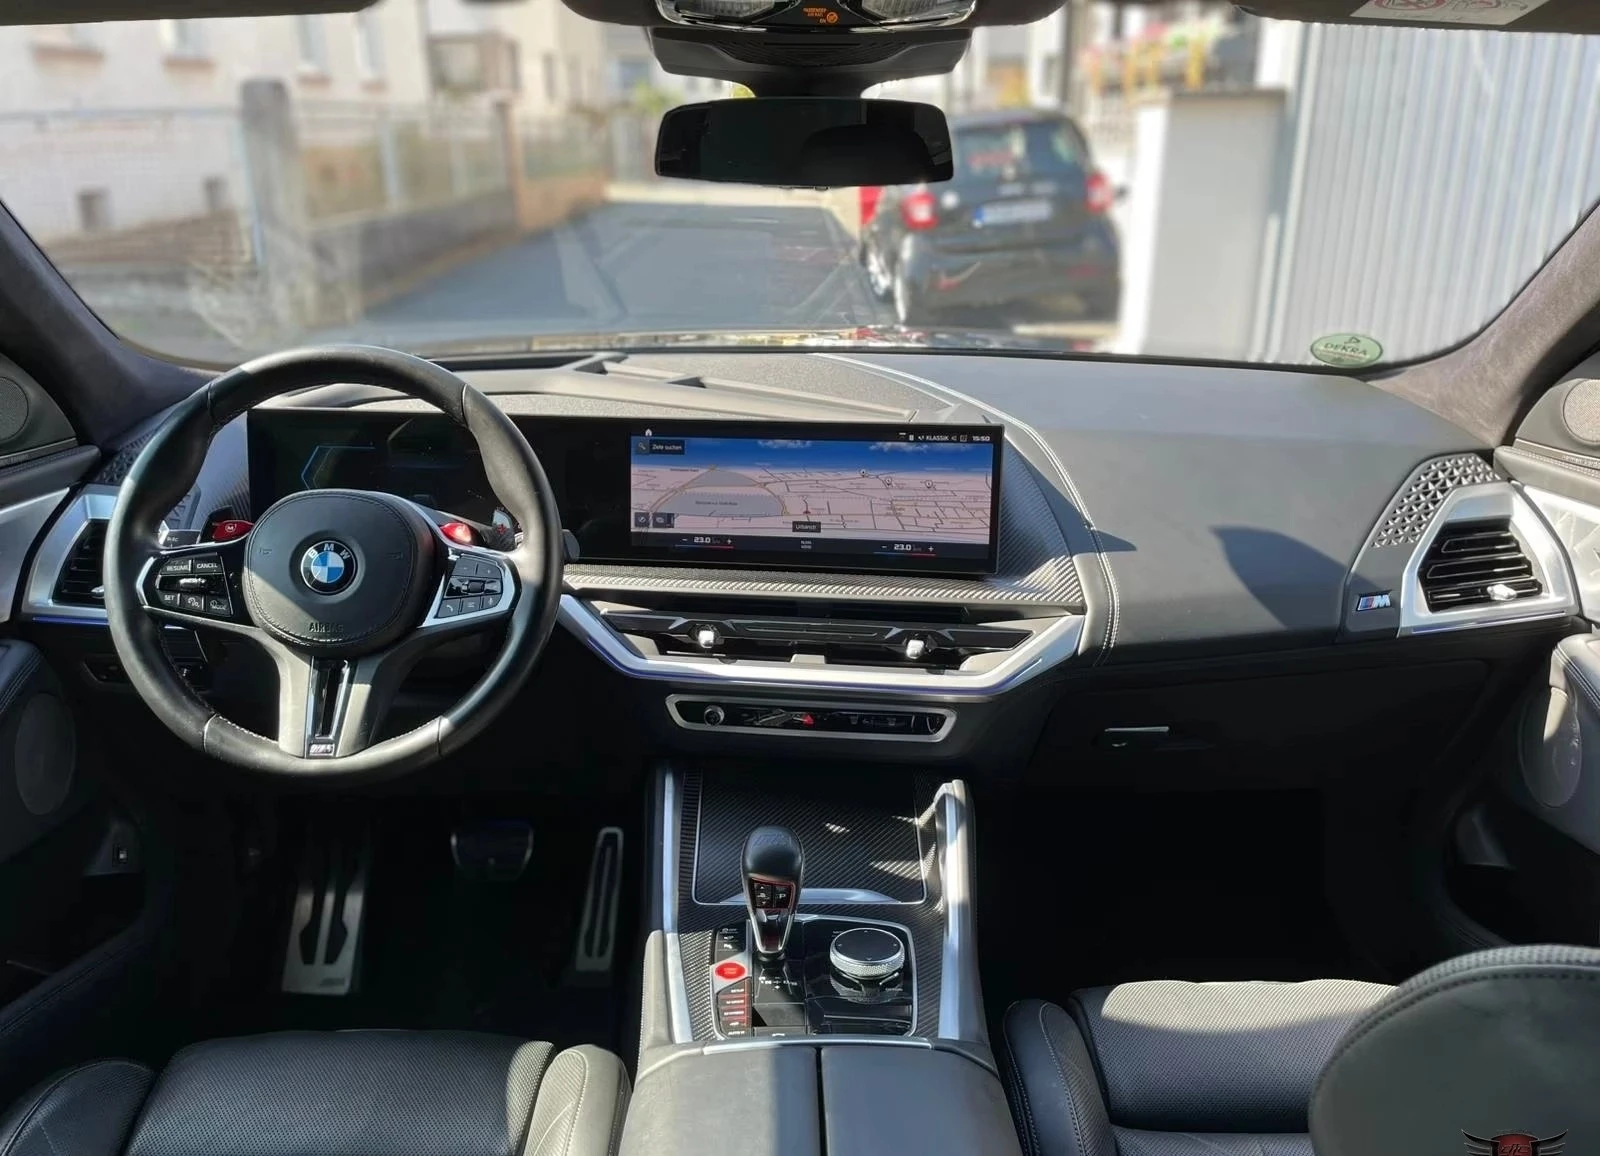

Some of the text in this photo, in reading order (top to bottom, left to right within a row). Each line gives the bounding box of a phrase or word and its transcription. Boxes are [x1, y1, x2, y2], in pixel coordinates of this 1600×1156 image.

[1324, 343, 1367, 355] DEKRA
[308, 543, 351, 560] BMW
[893, 543, 912, 551] 23.0
[309, 622, 344, 633] AIRBAG
